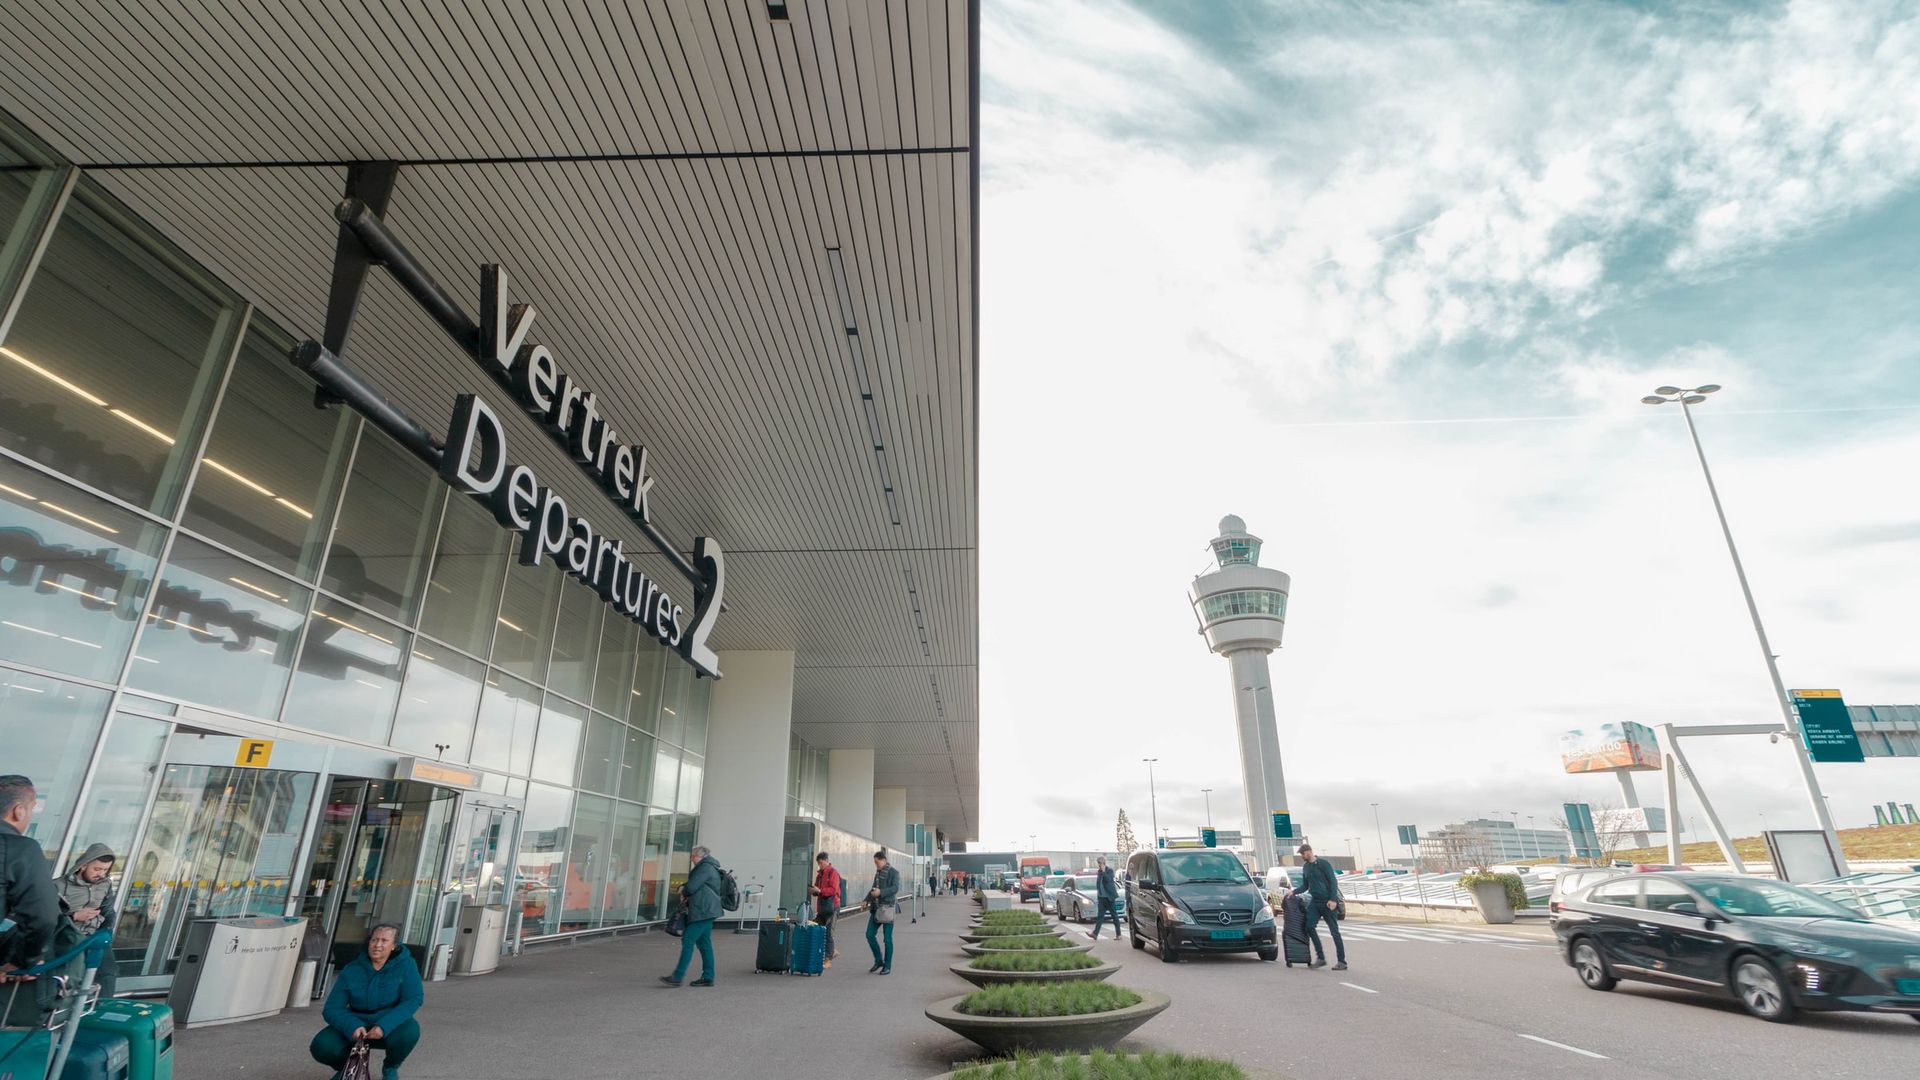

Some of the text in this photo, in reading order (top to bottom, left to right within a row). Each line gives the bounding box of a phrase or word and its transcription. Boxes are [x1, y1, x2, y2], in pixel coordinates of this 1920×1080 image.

[494, 264, 655, 523] Vertrek
[455, 395, 684, 648] Departures
[689, 537, 725, 677] 2
[246, 743, 264, 763] F
[241, 946, 255, 954] Help
